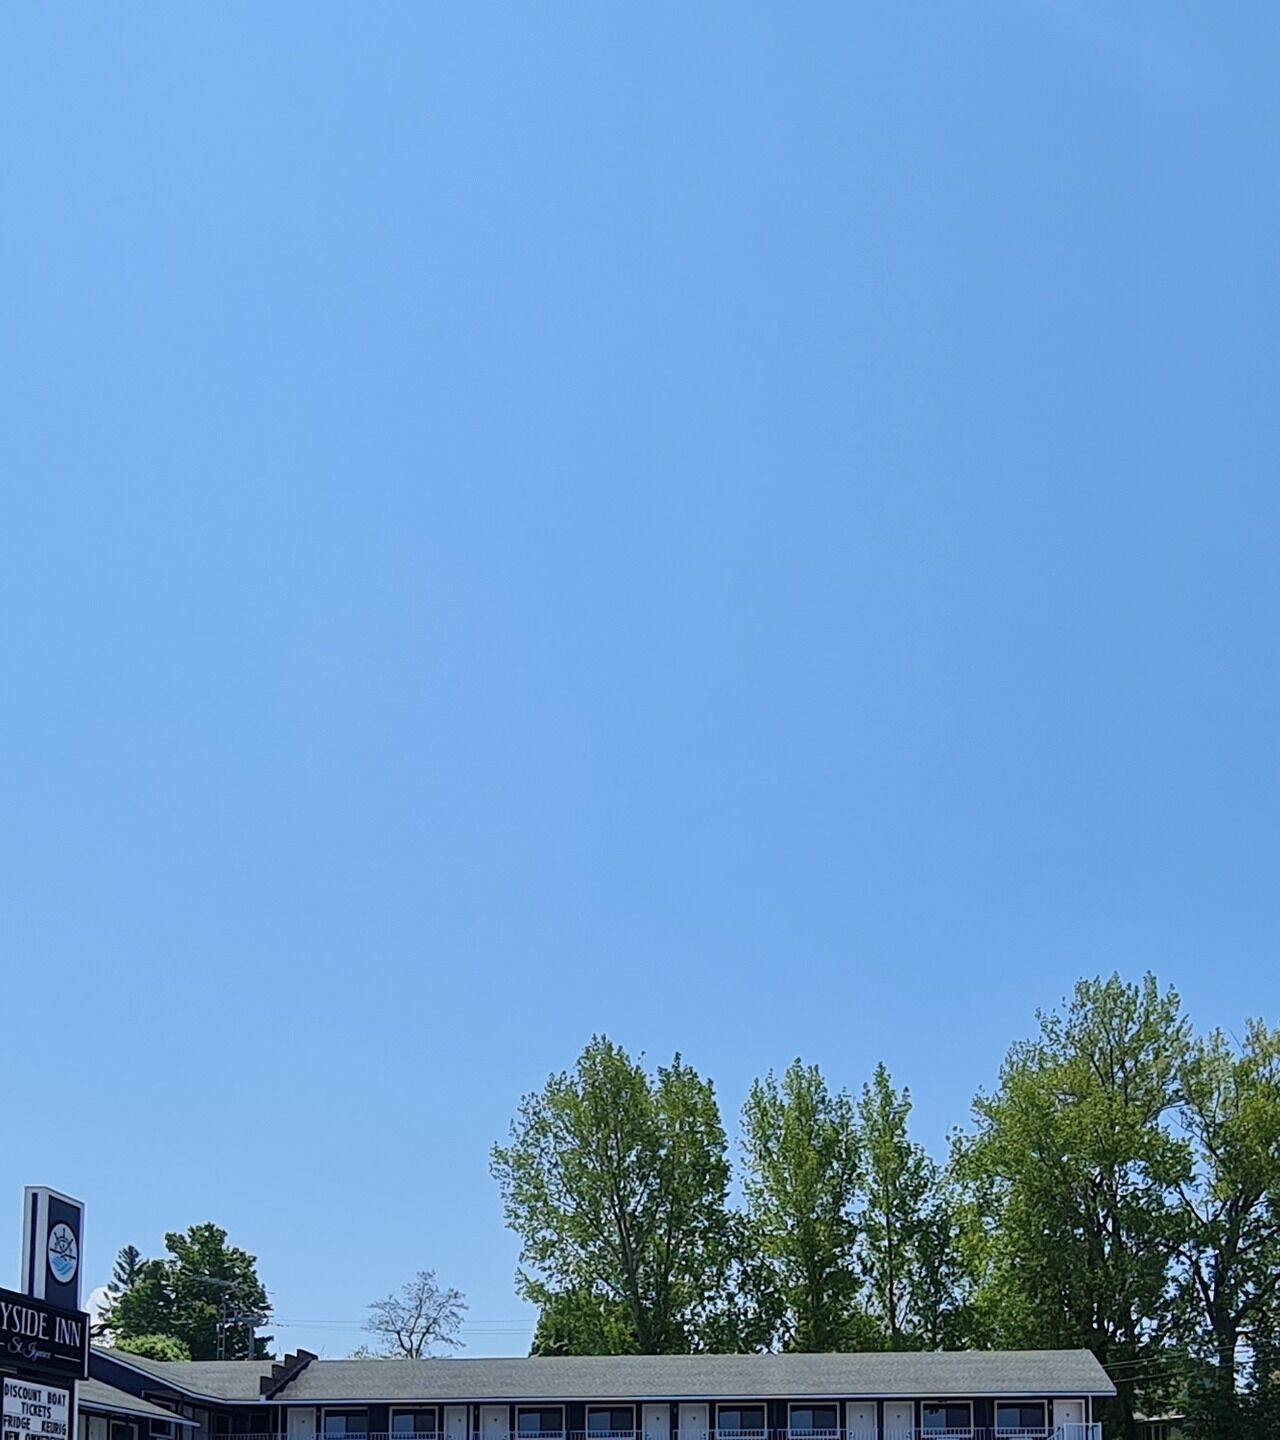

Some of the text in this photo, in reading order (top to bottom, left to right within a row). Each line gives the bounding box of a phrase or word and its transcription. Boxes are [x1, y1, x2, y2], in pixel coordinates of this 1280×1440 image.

[55, 1316, 81, 1348] INN
[4, 1383, 66, 1407] DISCOUNT BOAT
[21, 1402, 52, 1419] TICKETS
[3, 1415, 67, 1436] FRIDGE KEURIG
